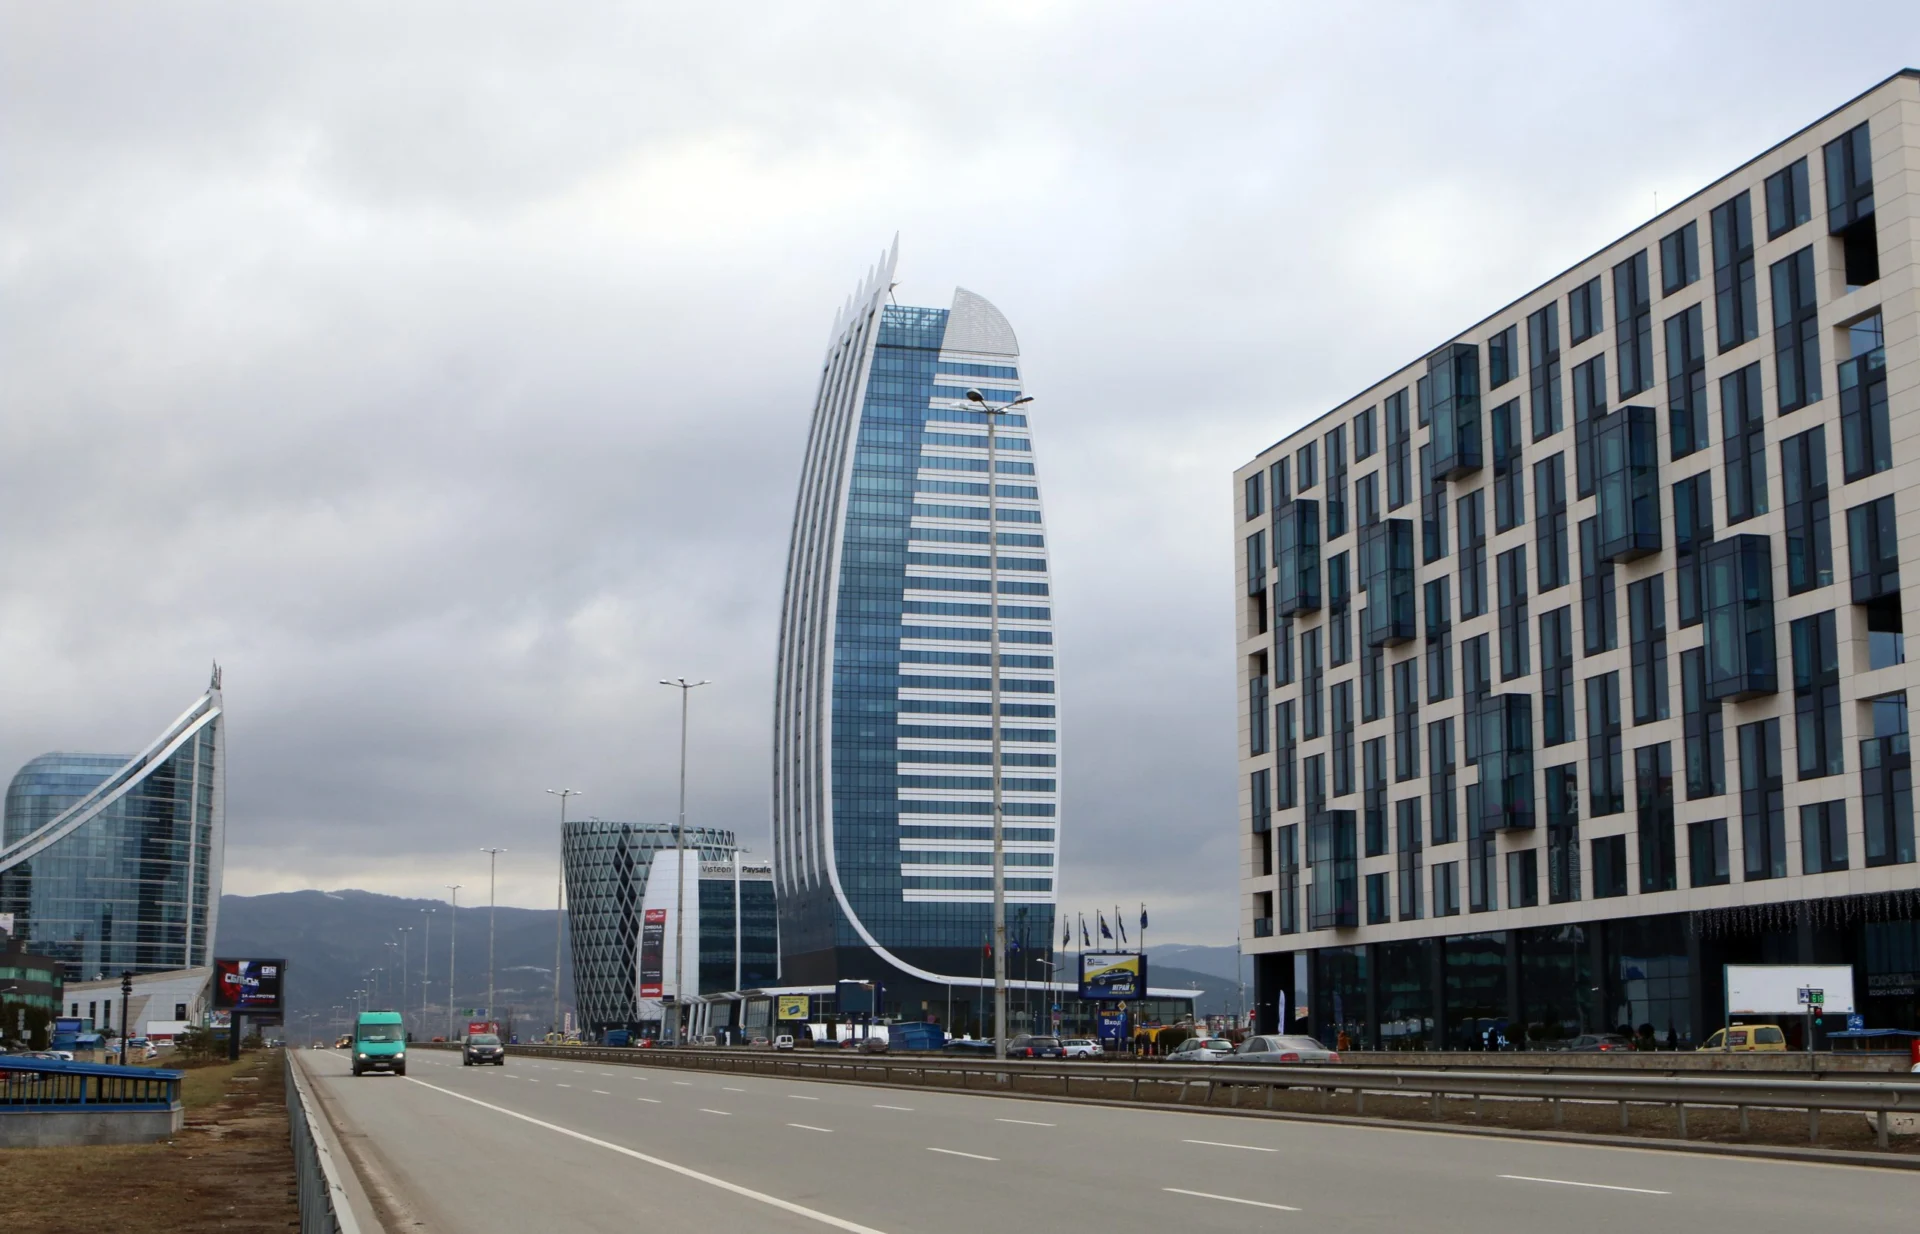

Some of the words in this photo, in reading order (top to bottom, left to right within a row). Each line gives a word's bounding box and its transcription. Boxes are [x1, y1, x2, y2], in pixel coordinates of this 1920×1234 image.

[702, 865, 732, 873] Visteon
[742, 866, 772, 874] Paysafe
[1104, 1018, 1121, 1026] Вход
